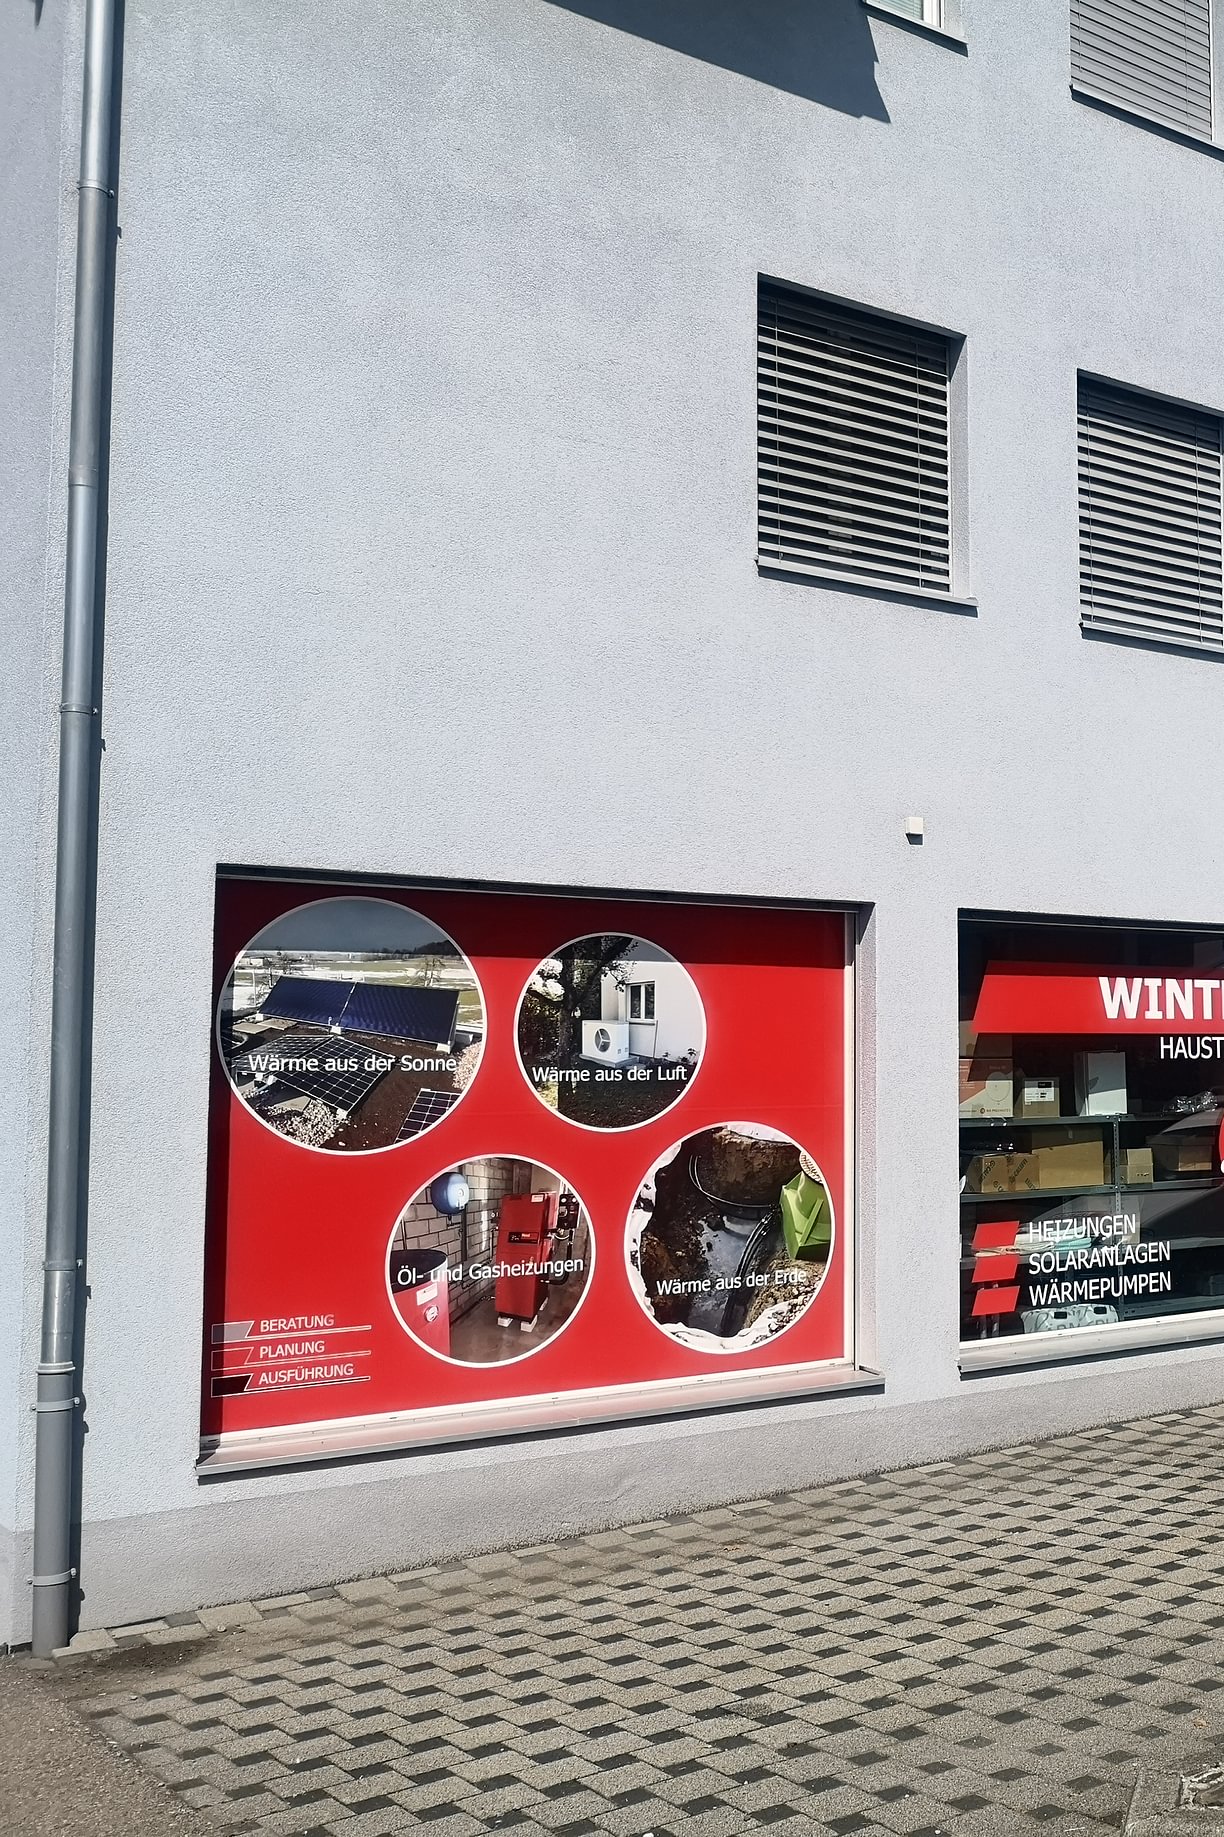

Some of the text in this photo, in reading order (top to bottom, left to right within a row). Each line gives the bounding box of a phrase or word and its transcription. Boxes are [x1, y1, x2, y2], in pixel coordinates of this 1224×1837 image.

[248, 1054, 457, 1072] Wärme aus der Sonne
[532, 1065, 688, 1082] Wärme aus der Luft
[1029, 1214, 1136, 1243] HEIZUNGEN
[1028, 1241, 1171, 1275] SOLARANLAGEN
[397, 1258, 584, 1285] Öl- und Gasheizungen
[656, 1268, 807, 1295] Wärme aus der Erde
[1029, 1271, 1171, 1306] WÄRMEPUMPEN
[260, 1314, 335, 1332] BERATUNG
[259, 1340, 325, 1358] PLANUNG
[258, 1363, 353, 1385] AUSFÜHRUNG
